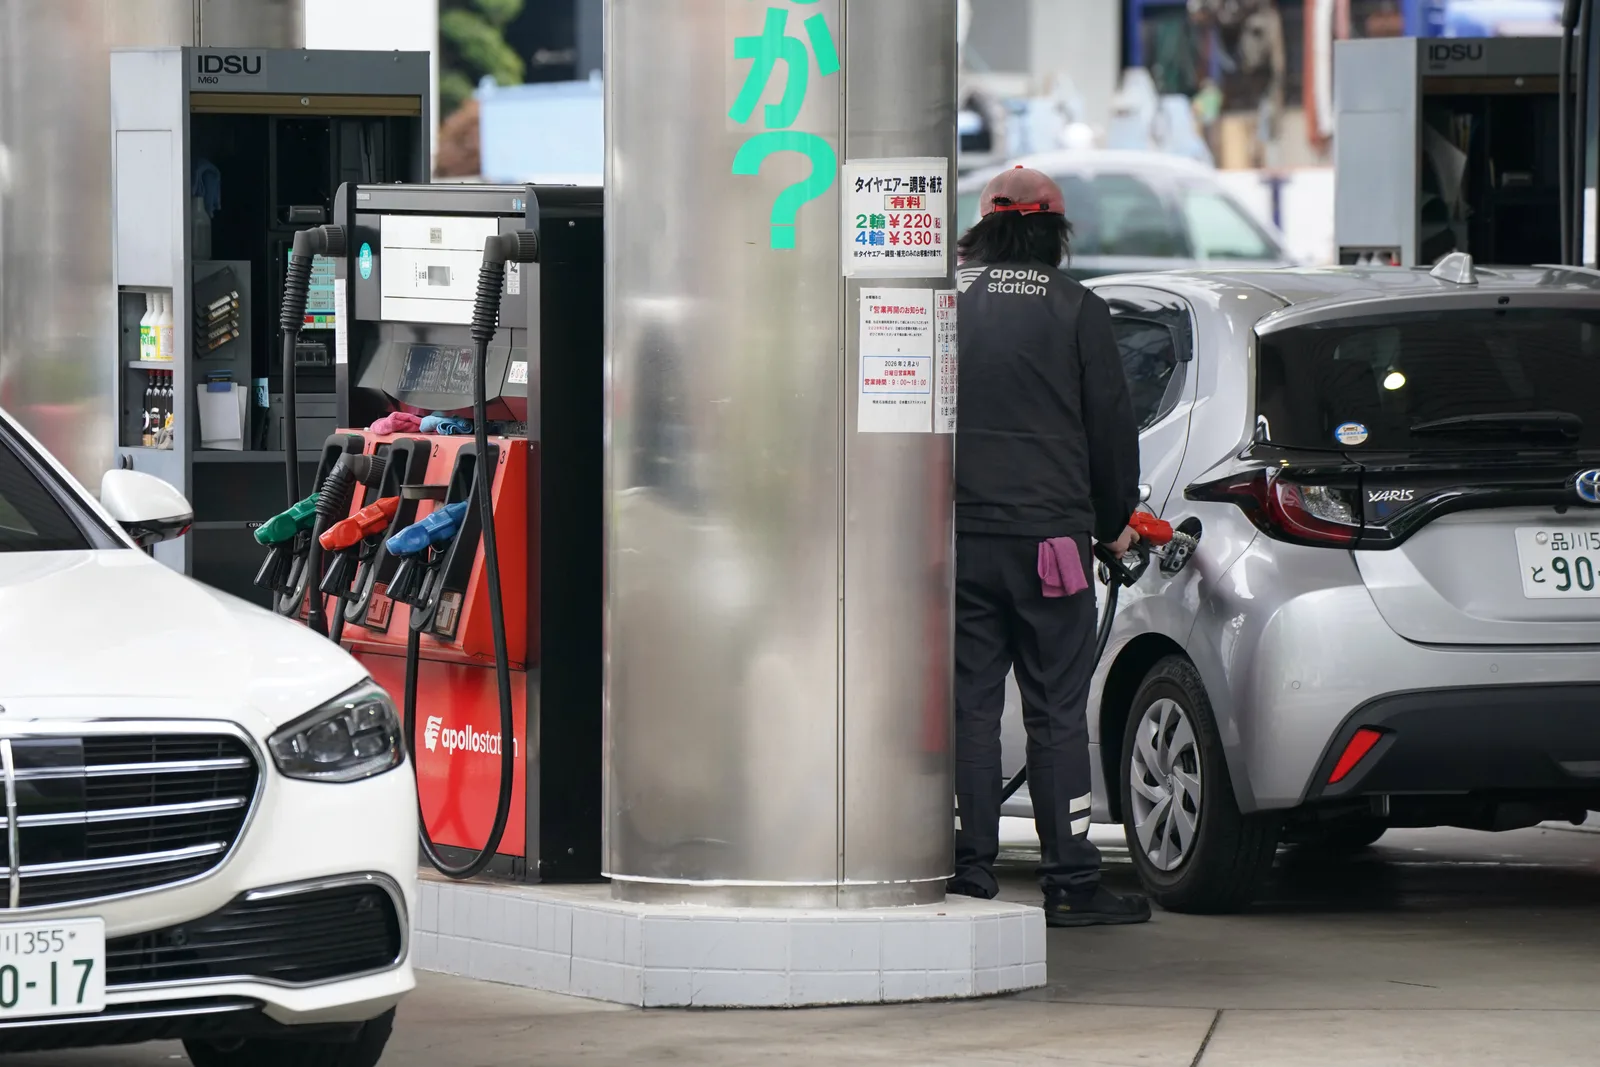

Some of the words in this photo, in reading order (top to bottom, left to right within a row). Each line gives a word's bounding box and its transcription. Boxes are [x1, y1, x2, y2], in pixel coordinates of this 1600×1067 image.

[1429, 44, 1483, 61] IDSU
[197, 55, 262, 75] IDSU
[197, 76, 219, 85] M60
[728, 0, 840, 250] か？
[855, 176, 942, 193] タイヤエアー調整・補充
[890, 196, 921, 209] 有料
[856, 213, 886, 229] 2輪
[855, 230, 885, 246] 4輪
[989, 269, 1050, 284] apollo
[987, 281, 1047, 296] station
[432, 444, 439, 458] 2
[499, 450, 506, 465] 3
[1367, 489, 1415, 502] YARIS
[1551, 556, 1600, 592] 90
[441, 724, 518, 758] apollostatn
